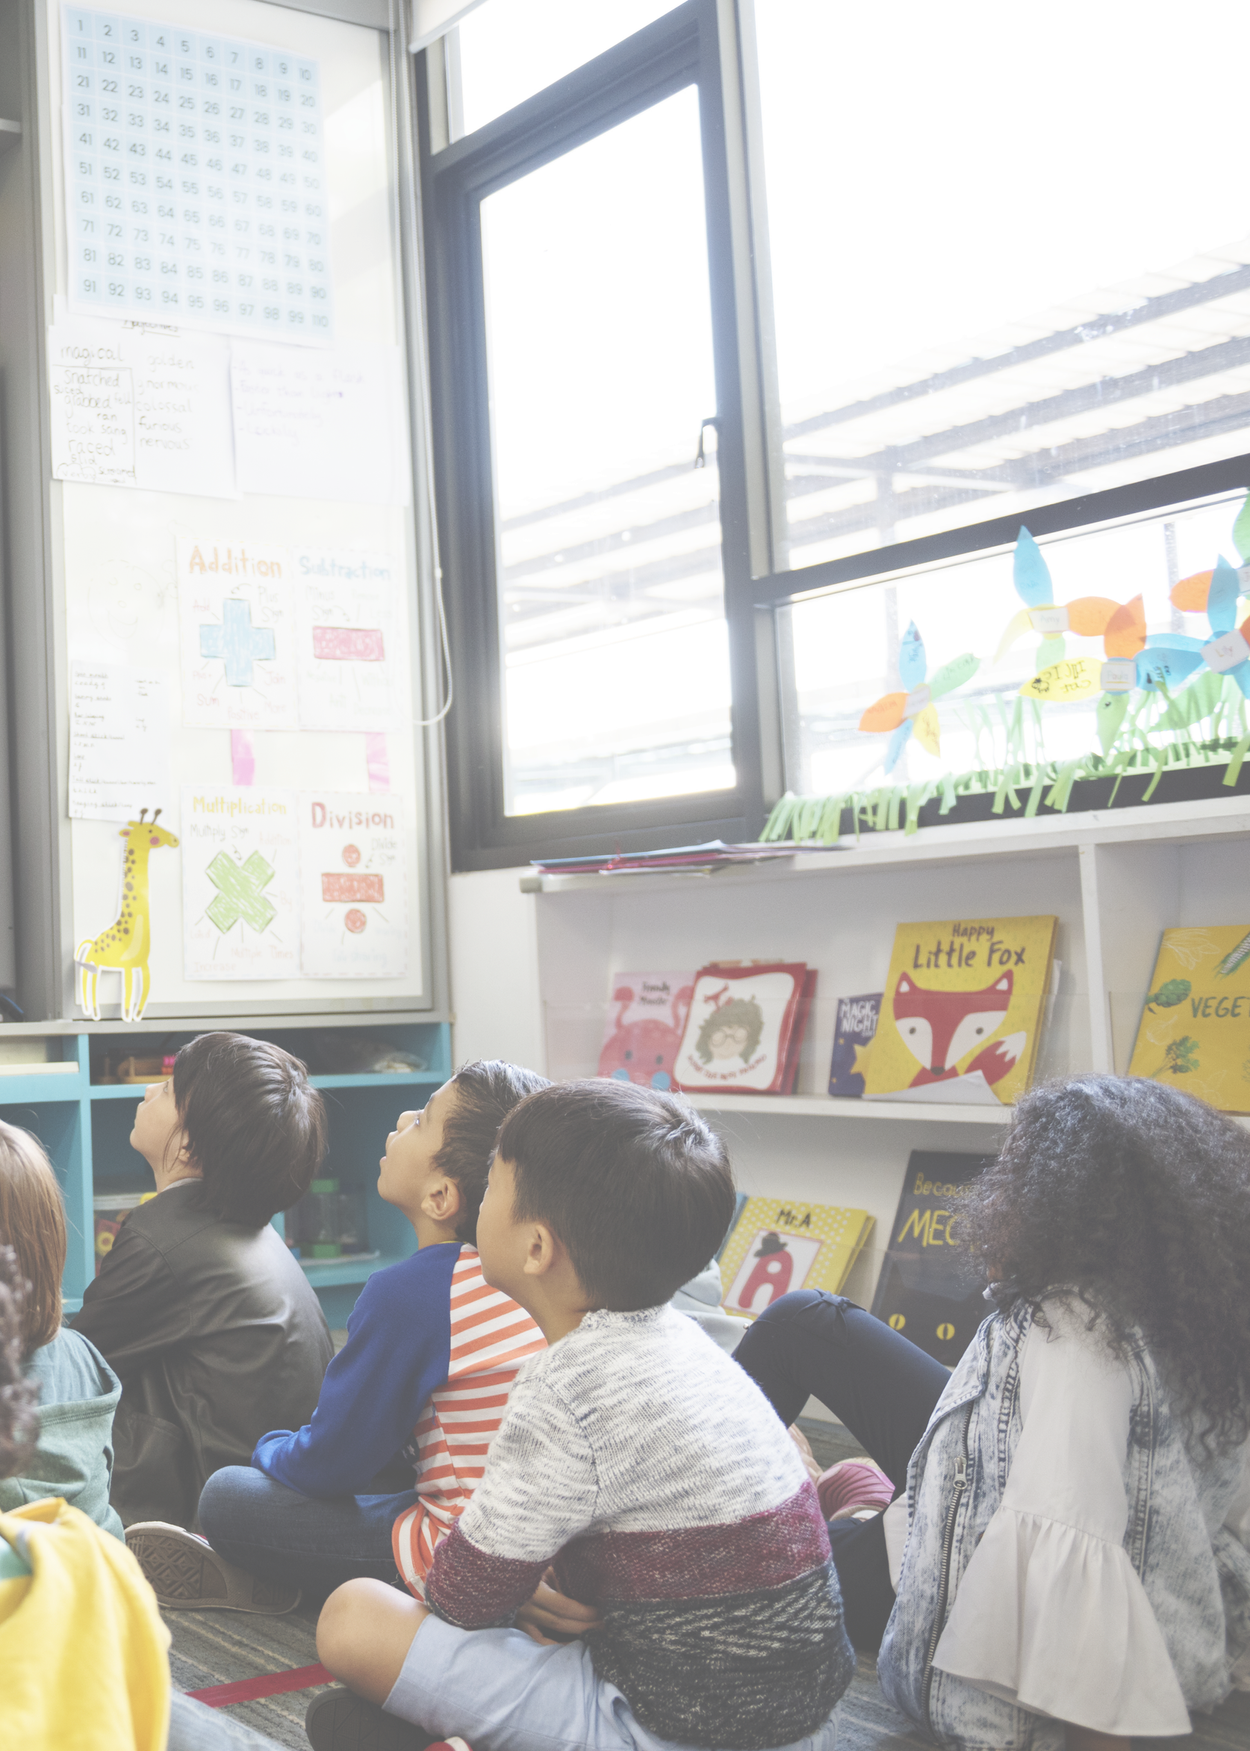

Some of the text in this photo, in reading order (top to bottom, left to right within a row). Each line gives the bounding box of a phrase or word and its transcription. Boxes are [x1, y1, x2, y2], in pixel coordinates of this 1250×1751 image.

[77, 18, 84, 32] 1
[103, 24, 112, 37] 2
[130, 28, 140, 43] 3
[156, 35, 166, 47] 4
[180, 39, 190, 54] 5
[76, 45, 194, 81] 11 12 13 14 15
[76, 74, 170, 104] 21 22 23 24
[77, 102, 171, 133] 31 32 33 34
[78, 132, 173, 162] 41 42 43 44
[78, 160, 174, 190] 51 52 53 54
[80, 190, 175, 219] 61 62 63 64
[81, 218, 176, 247] 71 72 73 74
[83, 247, 178, 275] 81 82 83 84
[83, 278, 179, 305] 91 92 93 94
[60, 342, 125, 367] magical
[147, 352, 195, 373] golden
[63, 391, 113, 419] grabbed
[96, 412, 118, 423] ran
[136, 398, 193, 414] colossal
[101, 424, 129, 445] sang
[138, 414, 183, 434] furious
[68, 437, 117, 457] raced
[139, 437, 192, 451] nervous
[189, 546, 283, 579] Addition
[299, 555, 392, 581] Subtraction
[197, 693, 221, 707] Sum
[192, 795, 288, 818] Multiplication
[311, 800, 395, 830] Division
[189, 823, 227, 844] Multiply
[952, 923, 996, 942] Happy
[913, 940, 1027, 969] Little Fox
[840, 1000, 876, 1018] MAGIC
[1191, 995, 1250, 1018] VEGE
[842, 1014, 879, 1033] NIGHT
